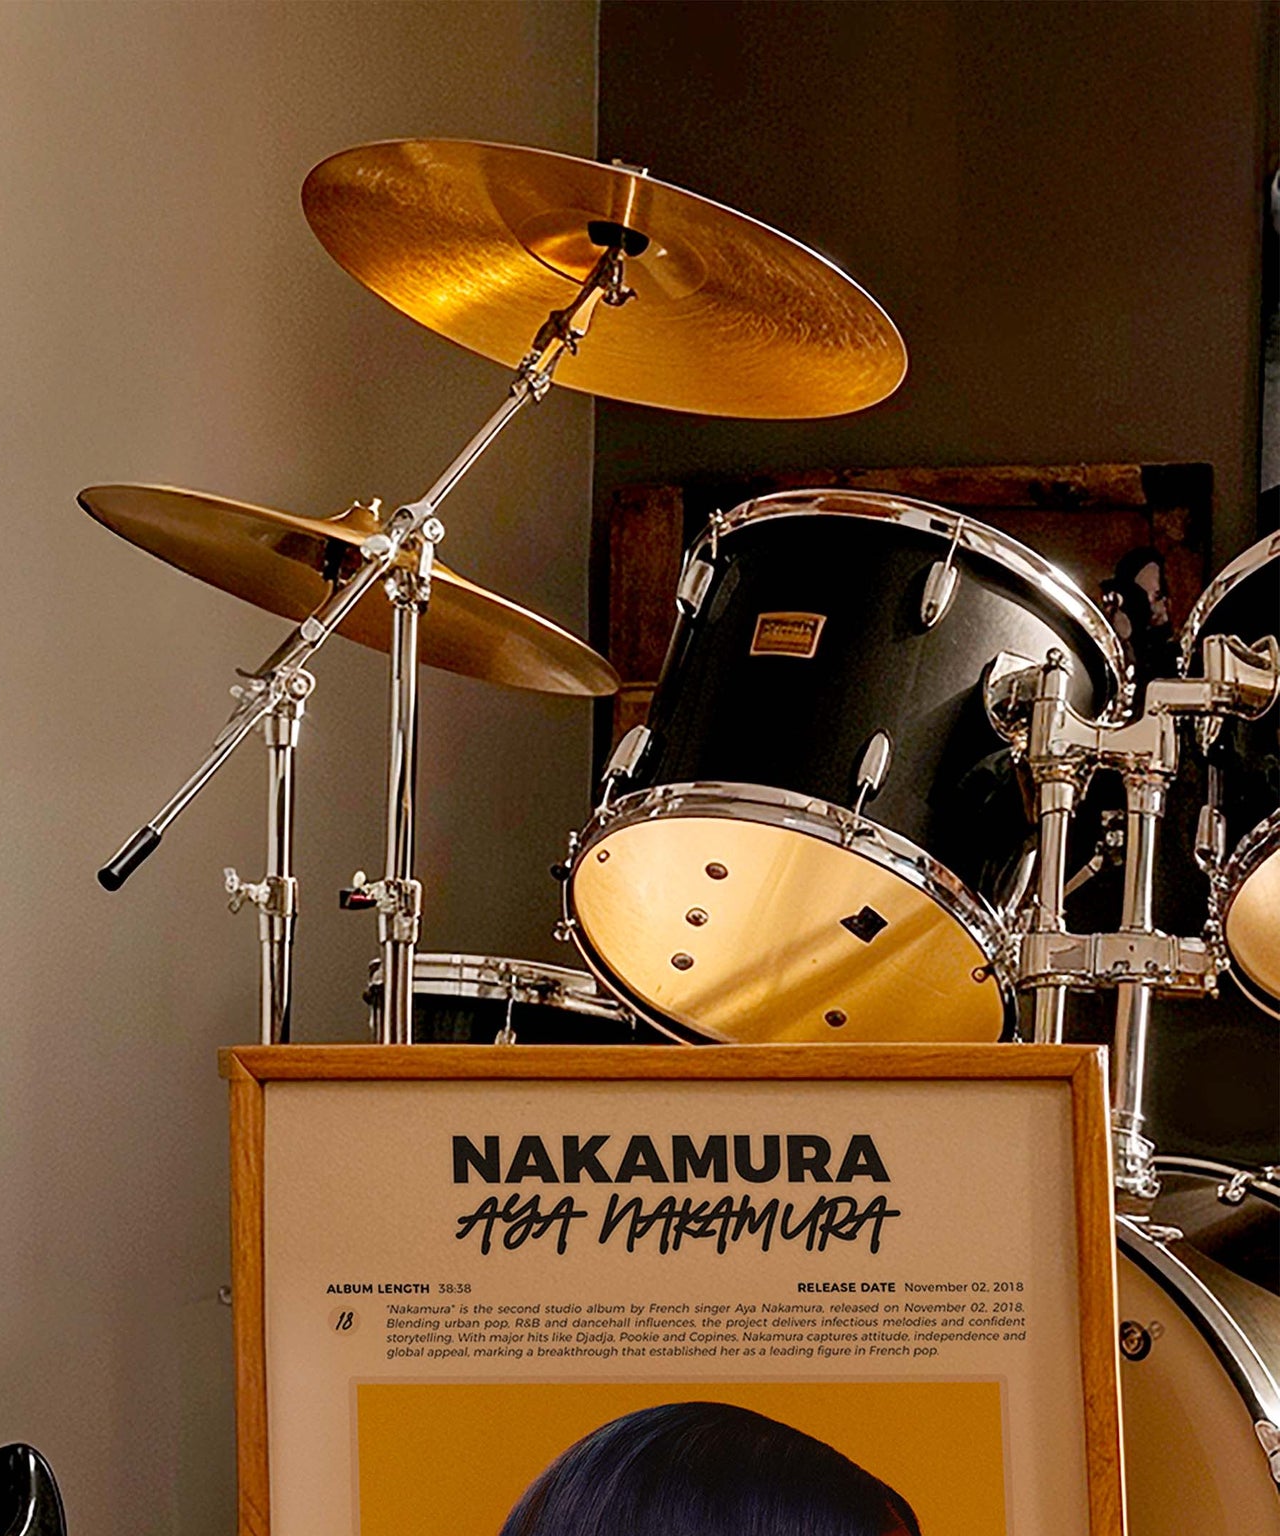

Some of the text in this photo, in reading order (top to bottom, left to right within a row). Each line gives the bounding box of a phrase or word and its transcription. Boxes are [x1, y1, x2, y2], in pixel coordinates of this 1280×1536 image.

[453, 1135, 890, 1183] NAKAMURA
[456, 1193, 901, 1255] AYA NAKAMURA
[326, 1283, 471, 1294] ALBUM LENGTH 38:38
[797, 1281, 1024, 1293] RELEASE DATE November 02, 2018
[336, 1312, 353, 1330] 18
